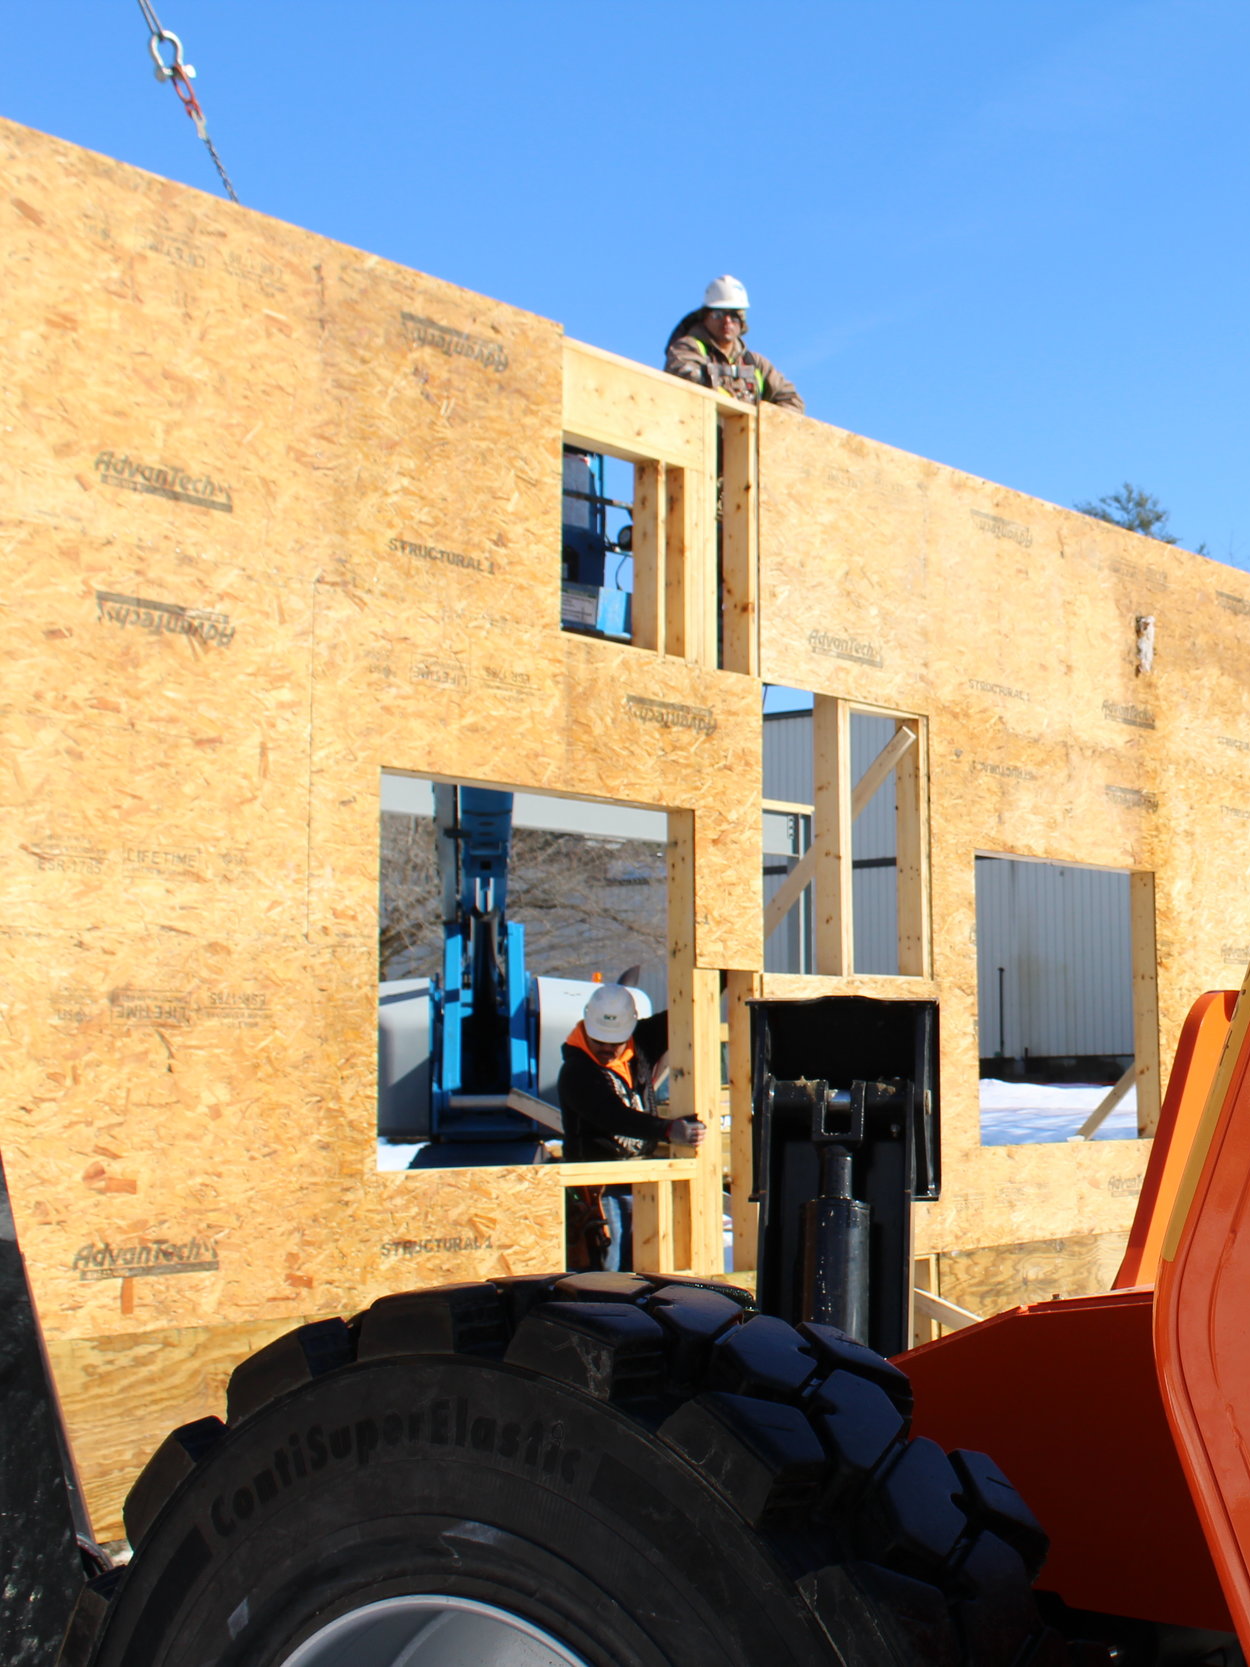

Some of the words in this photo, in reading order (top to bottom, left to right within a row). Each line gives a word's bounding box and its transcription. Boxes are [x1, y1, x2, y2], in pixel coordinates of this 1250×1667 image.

[387, 537, 484, 572] STRUCTURAL
[124, 847, 198, 868] LIFETIME
[115, 1004, 191, 1021] LIFETIME
